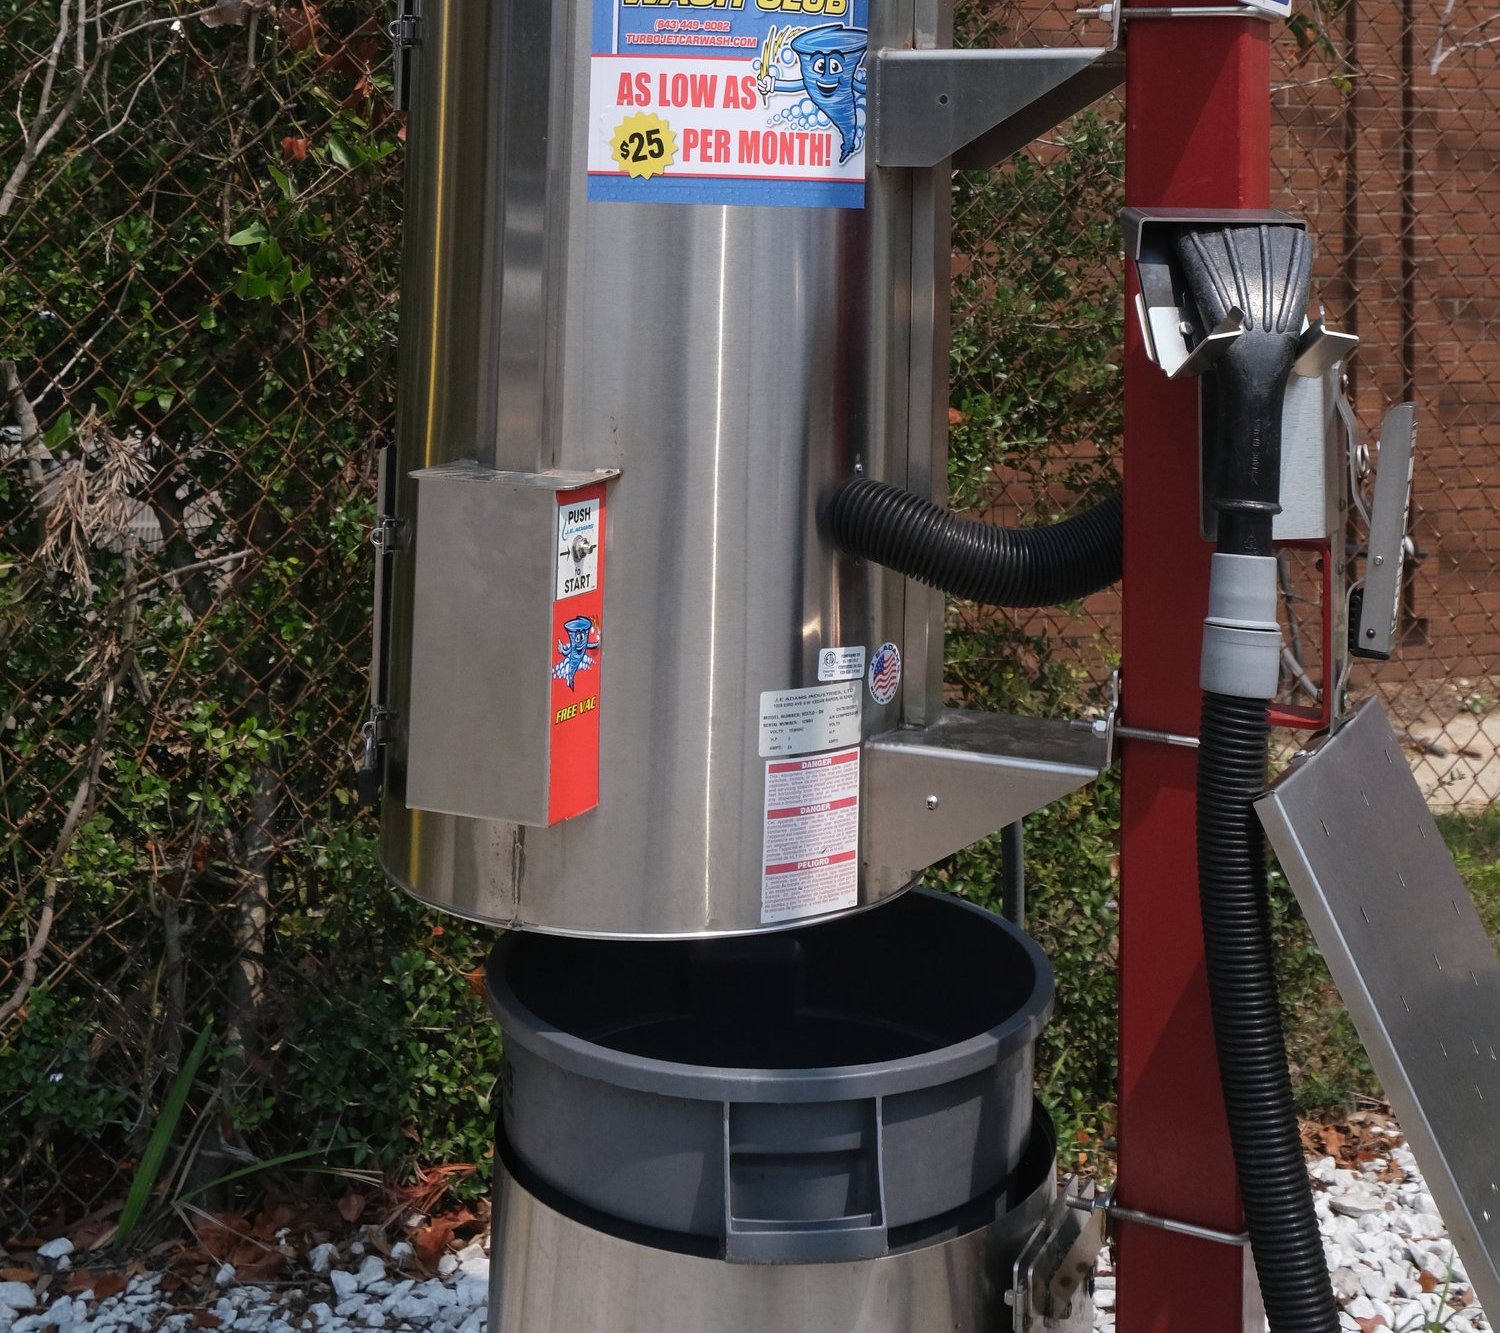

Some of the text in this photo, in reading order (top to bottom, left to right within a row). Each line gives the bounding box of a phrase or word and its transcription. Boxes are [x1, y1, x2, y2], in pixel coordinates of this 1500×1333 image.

[626, 33, 757, 48] TURBOJETCARWASH.COM
[616, 72, 758, 110] AS LOW AS
[620, 129, 665, 163] $25
[682, 128, 832, 167] PER MONTH!
[568, 507, 591, 524] PUSH
[574, 566, 581, 576] to
[564, 574, 591, 594] START
[785, 694, 807, 702] ADAMS
[555, 695, 597, 725] FREE VAC
[801, 758, 832, 769] DANGER
[800, 803, 831, 814] DANGER
[797, 857, 830, 869] PELIGRO
